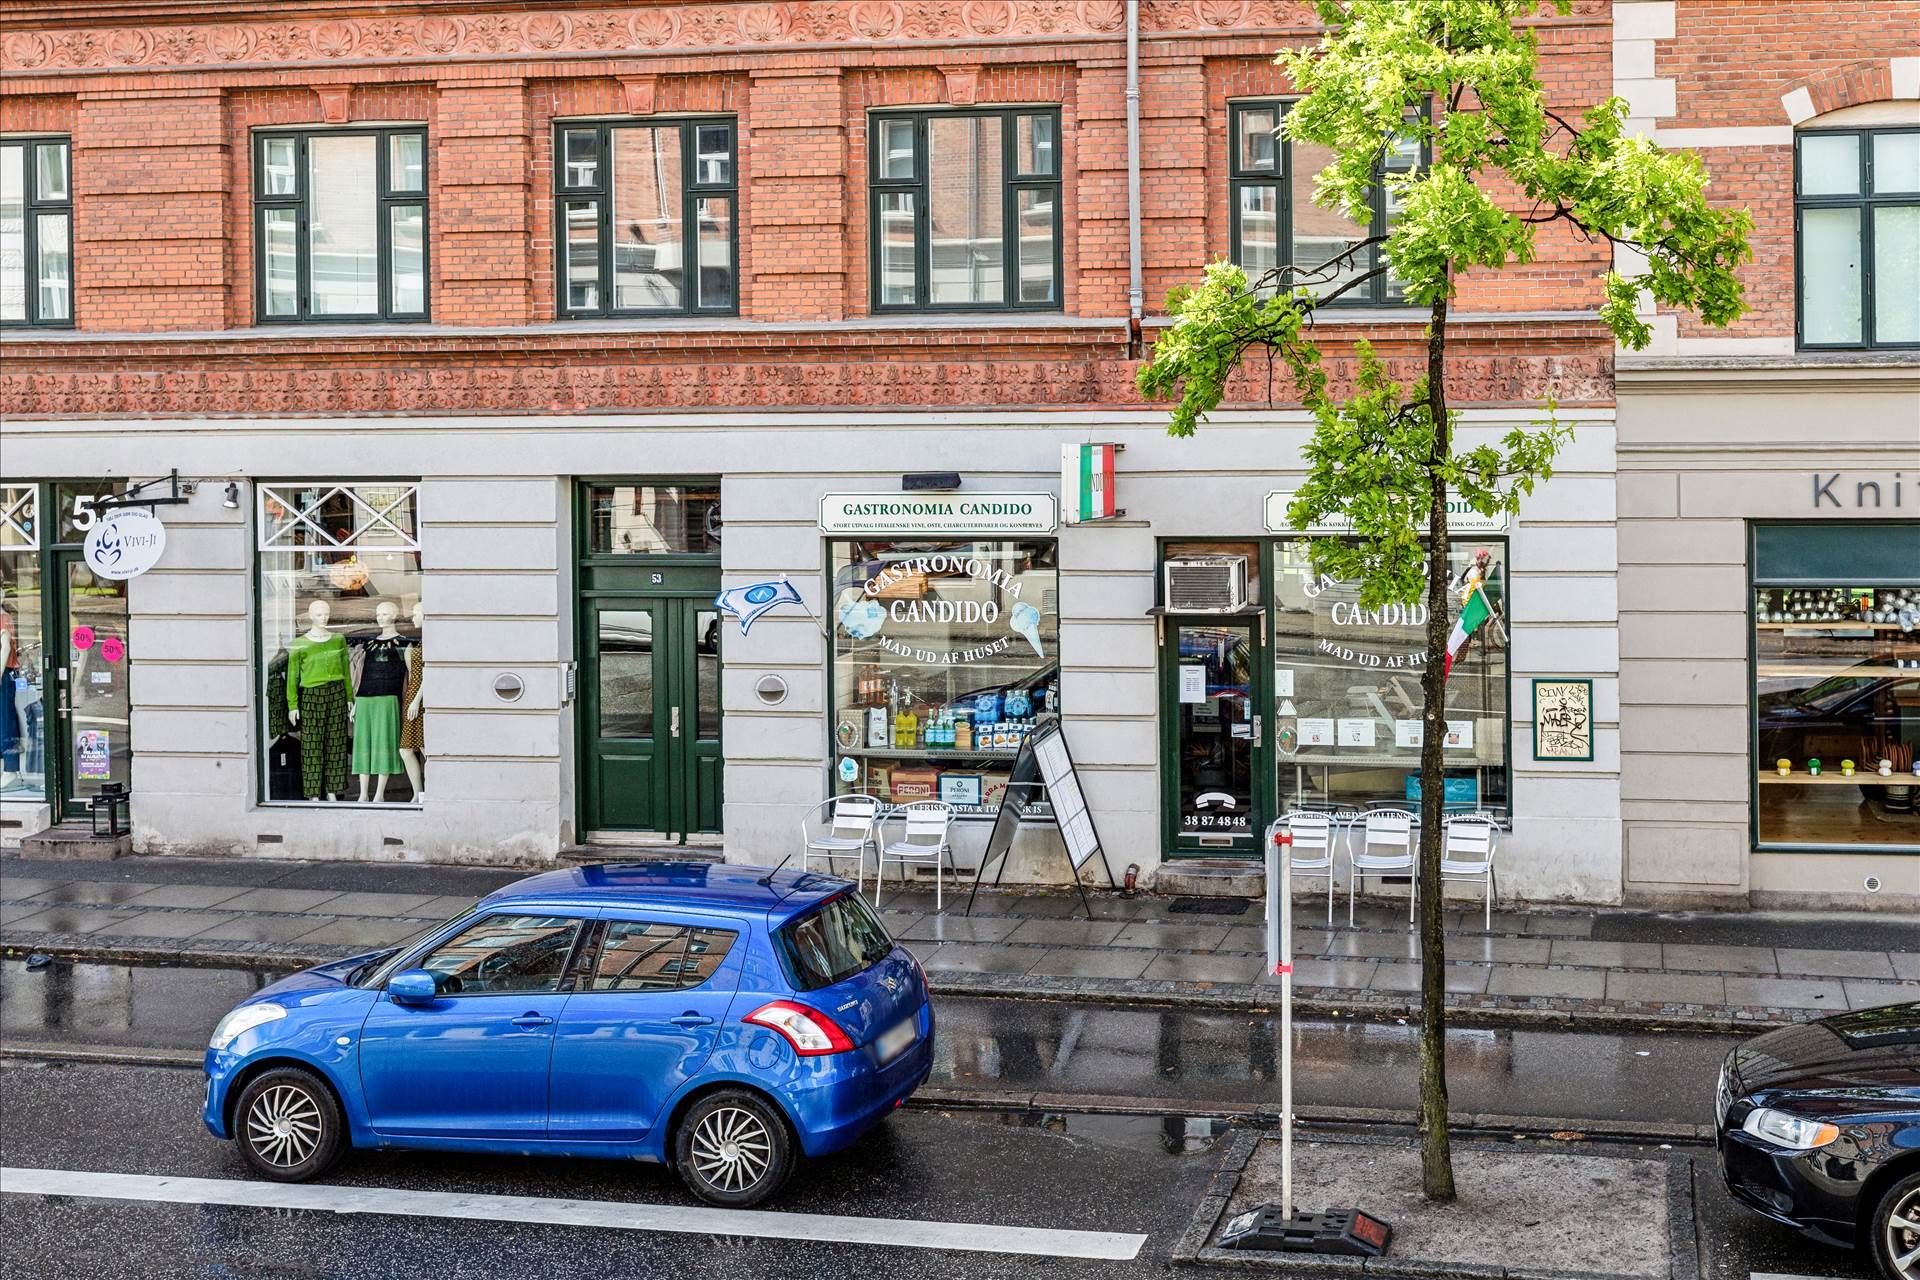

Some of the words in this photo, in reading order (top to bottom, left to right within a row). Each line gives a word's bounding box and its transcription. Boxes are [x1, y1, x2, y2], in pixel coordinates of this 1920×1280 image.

[1814, 472, 1920, 508] Kni
[843, 503, 953, 516] GASTRONOMIA
[960, 503, 1032, 516] CANDIDO
[651, 573, 662, 584] 53
[864, 554, 1023, 599] GASTRONOMIA
[890, 600, 998, 623] CANDIDO
[1331, 602, 1431, 626] CANDID
[878, 635, 911, 657] MAD
[916, 649, 937, 663] UD
[941, 652, 959, 663] AF
[963, 635, 1010, 662] HUSET
[1318, 638, 1354, 661] MAD
[1358, 654, 1381, 667] UD
[1385, 655, 1404, 667] AF
[898, 786, 929, 794] PERONI
[1184, 815, 1198, 826] 38
[1201, 815, 1215, 826] 87
[1217, 816, 1231, 827] 48
[1232, 816, 1246, 827] 48
